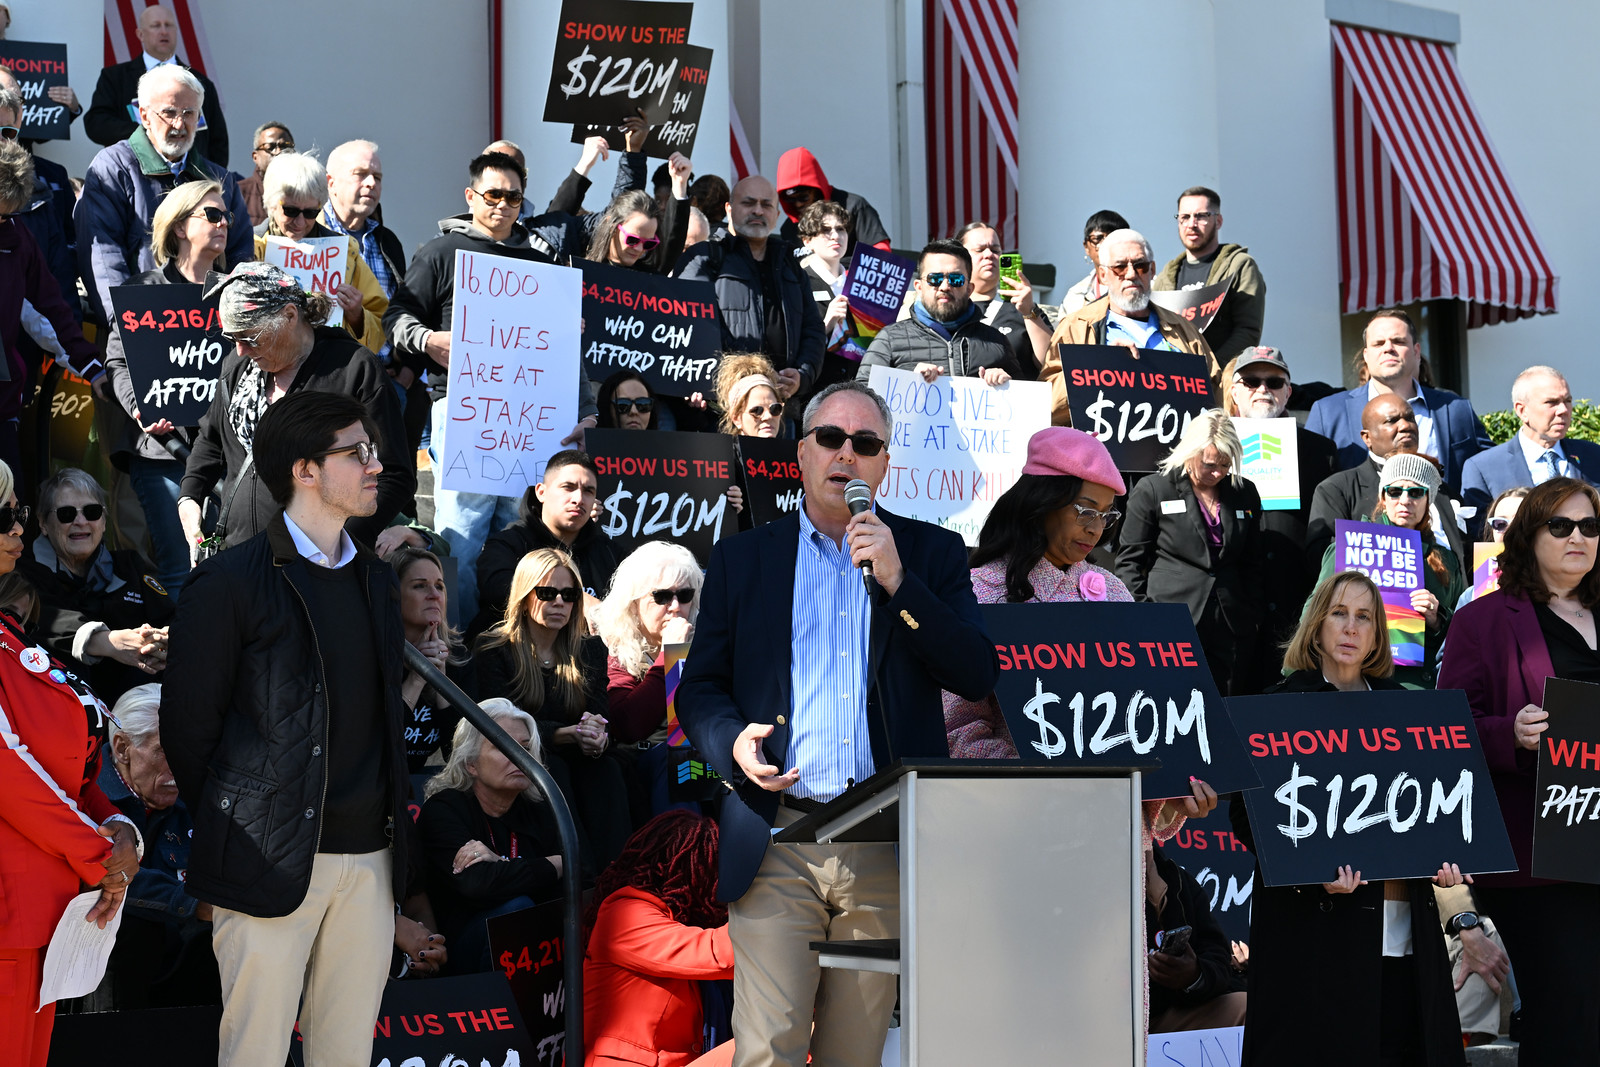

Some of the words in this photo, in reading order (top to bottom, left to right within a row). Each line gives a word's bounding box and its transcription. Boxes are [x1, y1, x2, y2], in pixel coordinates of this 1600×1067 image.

[564, 22, 627, 43] SHOW
[631, 26, 654, 44] US
[658, 27, 686, 44] THE
[0, 56, 65, 74] MONTH
[560, 44, 678, 107] $120M
[17, 79, 46, 100] AN
[657, 120, 696, 146] THAT?
[278, 245, 340, 271] TRUMP
[860, 253, 880, 271] WE
[881, 260, 907, 281] WILL
[311, 270, 341, 296] NO
[461, 253, 539, 298] 16.000
[854, 266, 886, 288] NOT
[885, 276, 905, 296] BE
[582, 280, 715, 319] $4,216/MONTH
[850, 281, 900, 310] ERASED
[605, 315, 644, 341] WHO
[651, 323, 694, 350] CAN
[168, 338, 223, 371] WHO
[585, 341, 656, 373] AFFORD
[659, 355, 718, 382] THAT?
[458, 352, 505, 388] ARE
[514, 365, 545, 387] AT
[1071, 368, 1136, 388] SHOW
[1140, 372, 1168, 391] US
[1170, 374, 1209, 396] THE
[452, 396, 557, 432] STAKE
[475, 429, 535, 452] SAVE
[889, 421, 912, 447] RE
[923, 425, 950, 450] AT
[956, 427, 1012, 455] STAKE
[594, 456, 657, 477] SHOW
[662, 458, 689, 478] US
[692, 460, 730, 479] THE
[926, 468, 964, 501] CAN
[601, 480, 728, 546] $120M
[1345, 531, 1373, 548] WE
[1375, 534, 1416, 554] WILL
[1345, 546, 1387, 567] NOT
[1391, 551, 1417, 571] BE
[995, 643, 1086, 671] SHOW
[1094, 641, 1136, 669] US
[1138, 642, 1199, 668] THE
[1022, 677, 1212, 765] $120M
[1248, 728, 1349, 758] SHOW
[1358, 728, 1401, 752] US
[1406, 725, 1471, 751] THE
[1274, 761, 1474, 848] $120M
[500, 937, 565, 980] $4,21
[400, 1014, 444, 1037] US
[448, 1007, 514, 1034] THE
